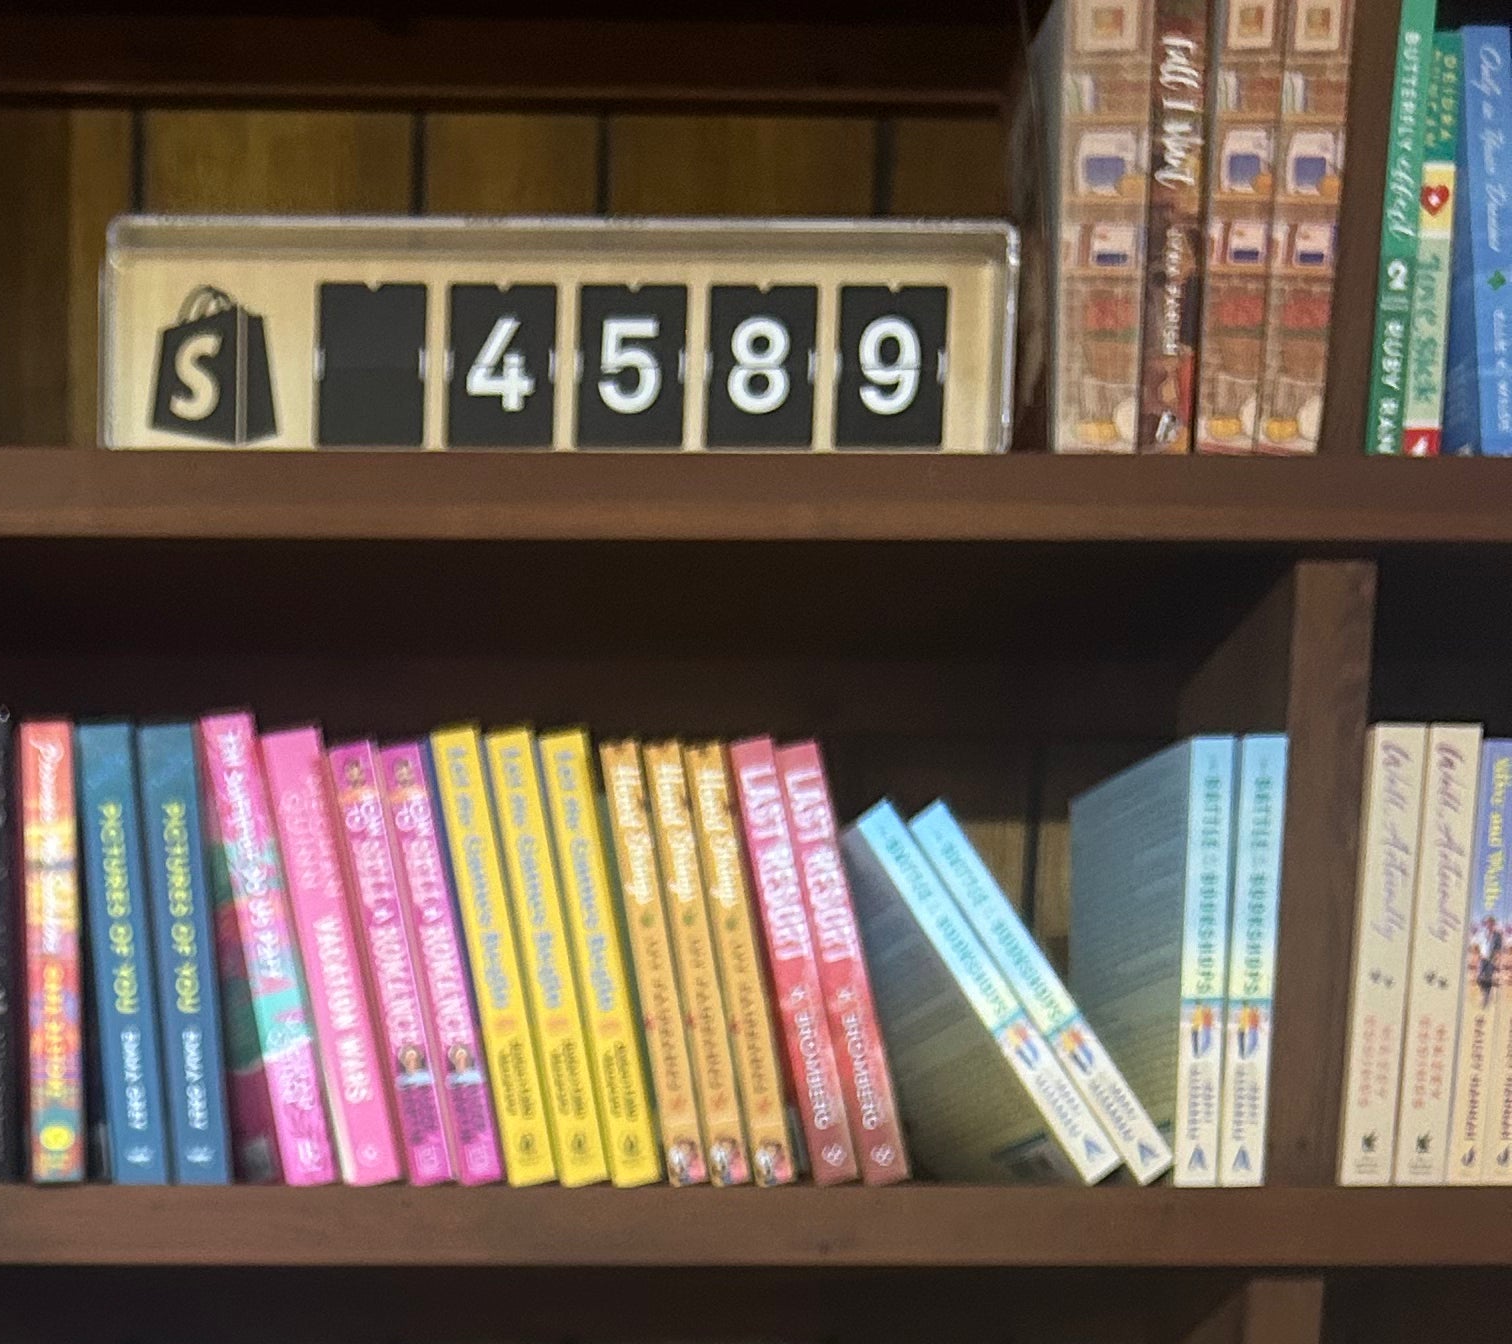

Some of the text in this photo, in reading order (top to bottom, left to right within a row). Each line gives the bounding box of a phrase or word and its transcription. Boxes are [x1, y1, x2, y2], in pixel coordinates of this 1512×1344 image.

[1397, 30, 1420, 151] BUTTERFLY
[740, 764, 809, 964] LAST RESORT
[788, 768, 838, 845] LAST
[97, 801, 138, 1016] PICTURES OF YOU
[161, 801, 202, 1014] PICTURES OF YOU
[311, 914, 371, 1104] VACATION WARS
[369, 926, 419, 1047] ROMANCE
[422, 926, 472, 1047] ROMANCE
